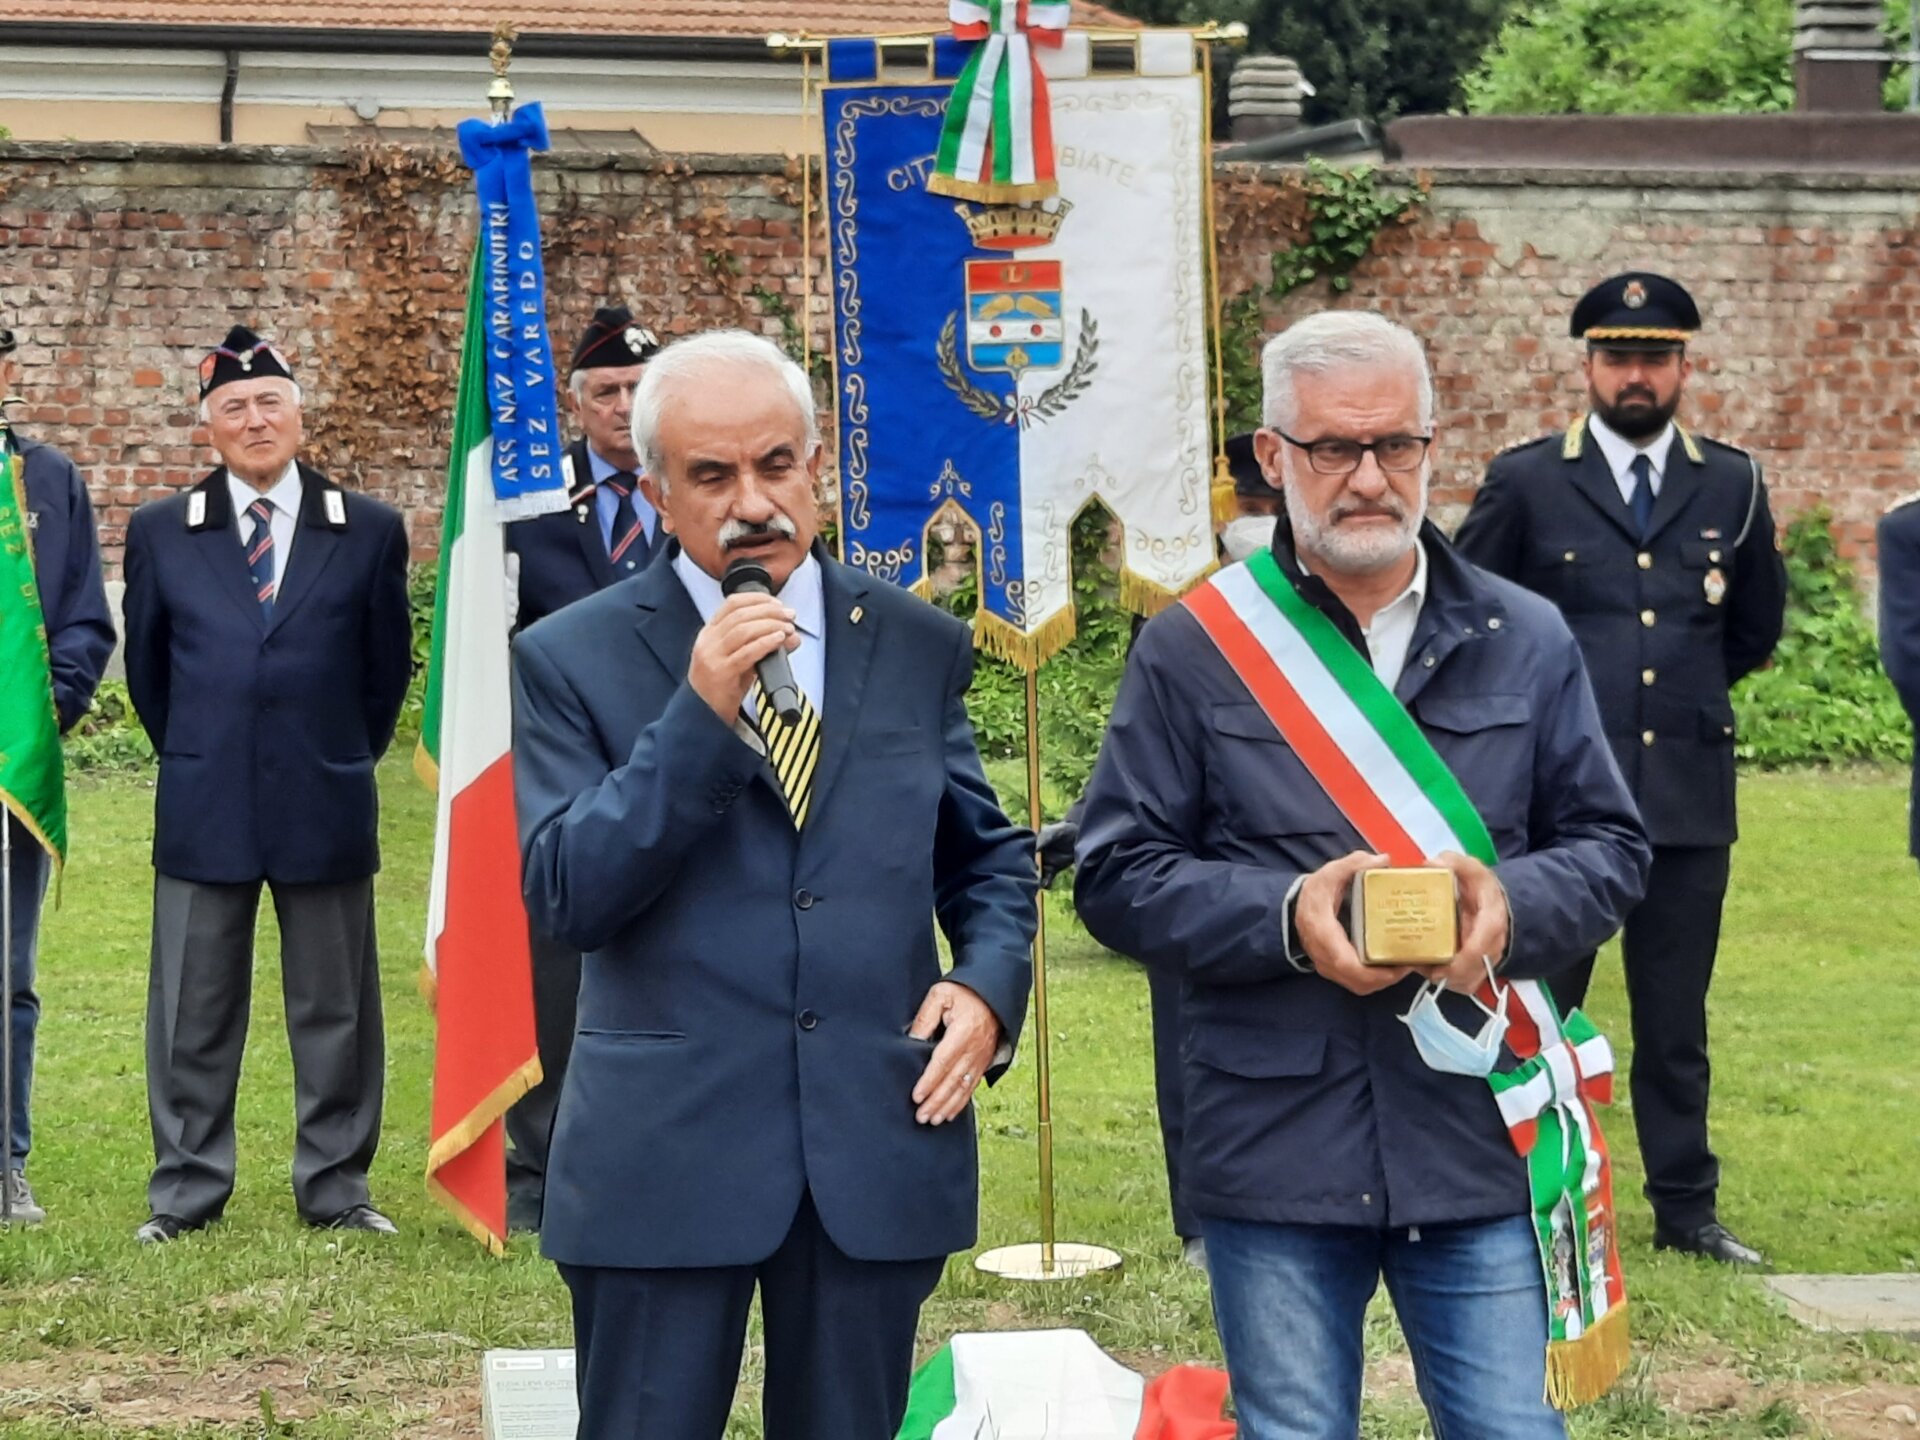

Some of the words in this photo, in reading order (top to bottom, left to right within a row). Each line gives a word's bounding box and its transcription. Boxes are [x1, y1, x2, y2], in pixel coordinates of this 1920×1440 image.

[887, 154, 937, 191] CIT
[1056, 144, 1137, 188] BIATE
[518, 241, 545, 388] VAREDO
[495, 373, 517, 423] NAZ
[498, 439, 520, 483] ASS
